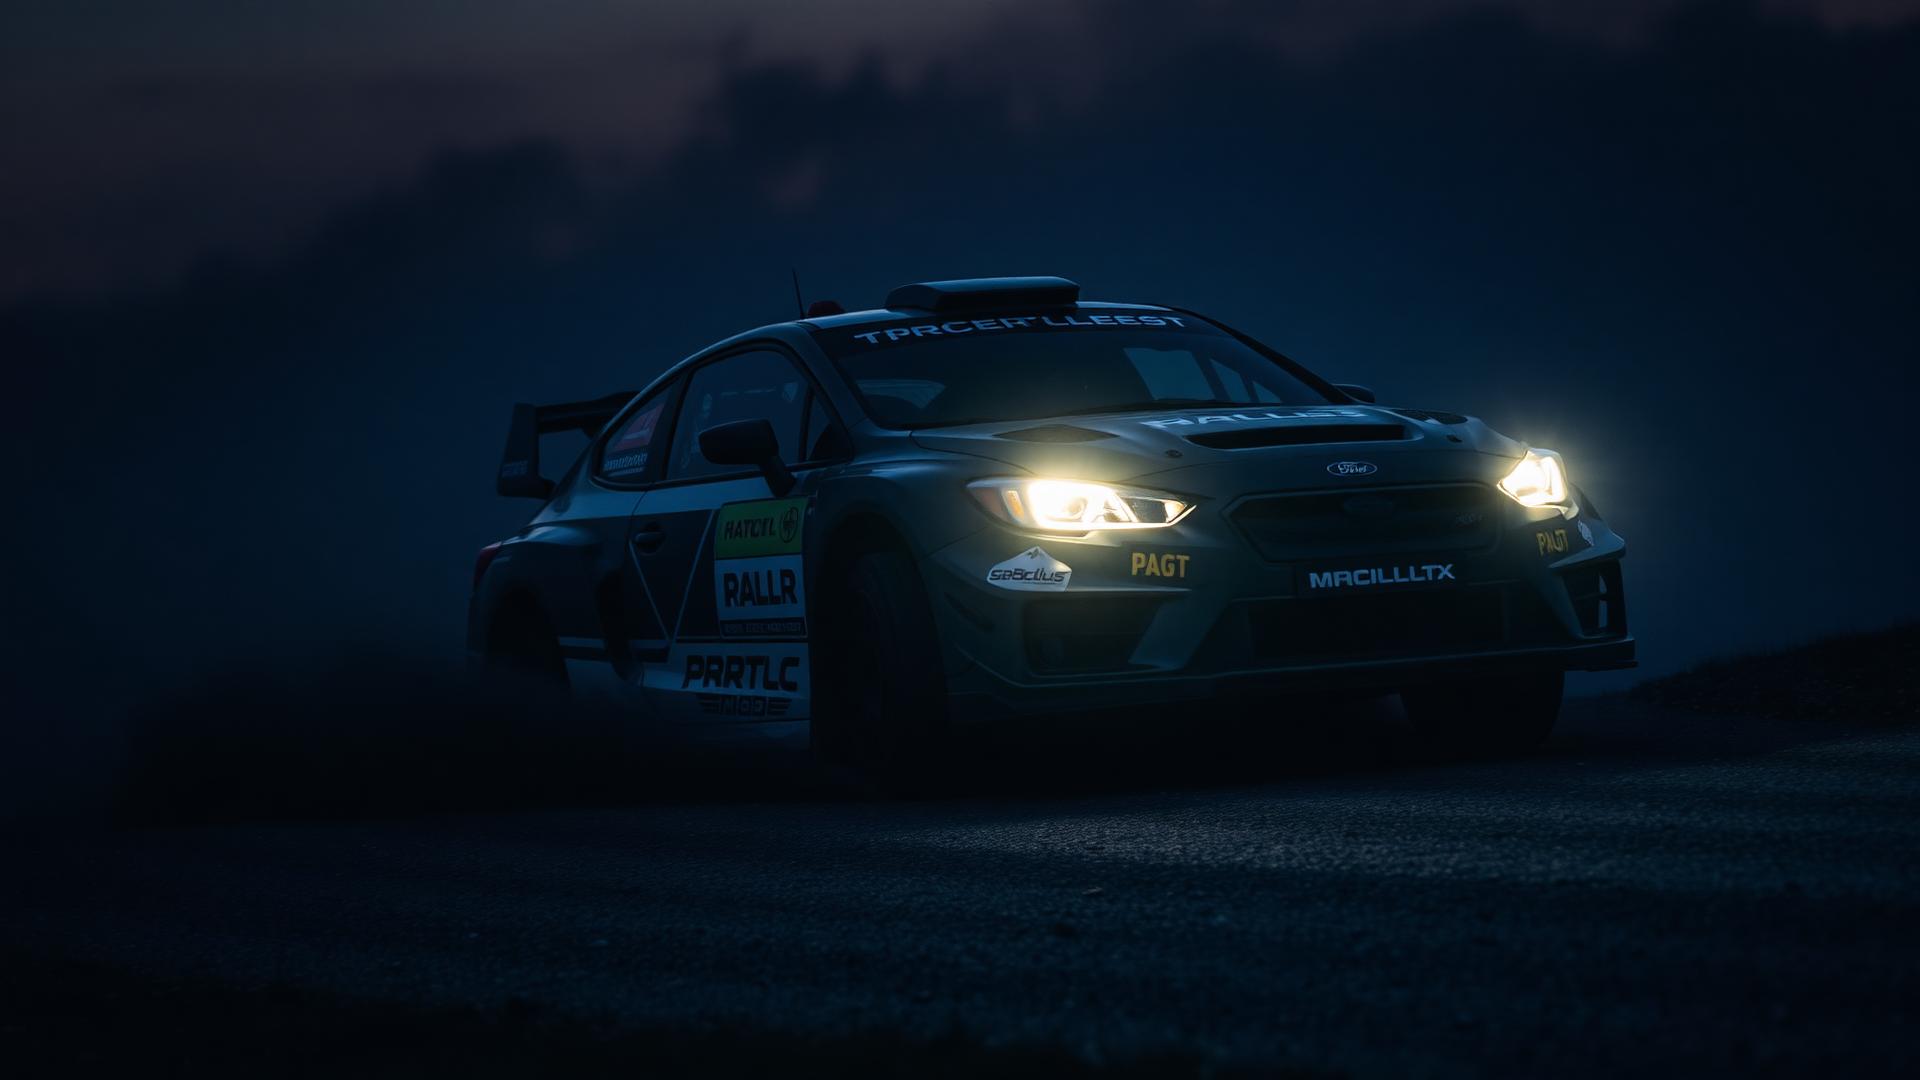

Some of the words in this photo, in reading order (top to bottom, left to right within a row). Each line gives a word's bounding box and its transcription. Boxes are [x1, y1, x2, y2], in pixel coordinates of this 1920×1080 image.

[1131, 552, 1190, 578] PAGT
[724, 569, 798, 608] RALLR
[683, 655, 800, 691] PRRTLC
